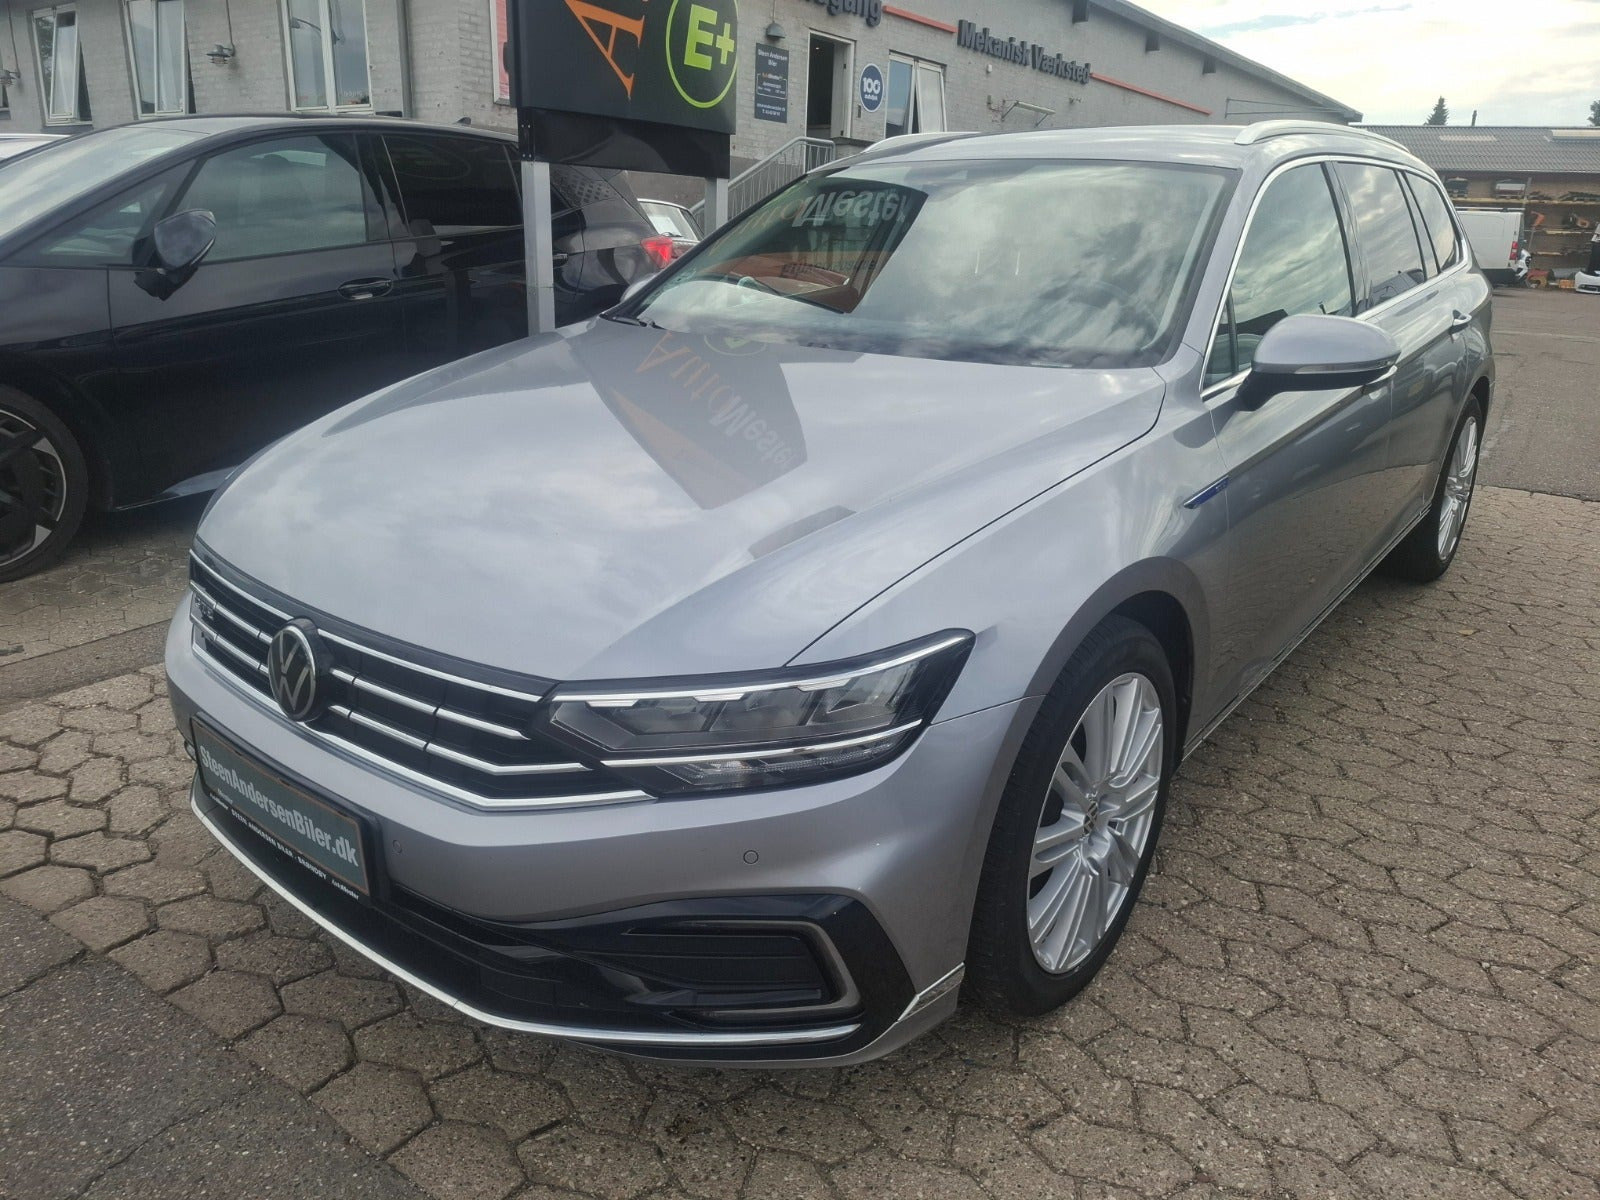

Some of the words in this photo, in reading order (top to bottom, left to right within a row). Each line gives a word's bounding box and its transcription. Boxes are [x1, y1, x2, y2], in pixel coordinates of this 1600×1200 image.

[806, 0, 881, 27] gang
[957, 20, 1030, 66] Mekanisk
[1031, 44, 1091, 84] Værksted
[200, 745, 359, 867] SteenAndersenBiler.dk
